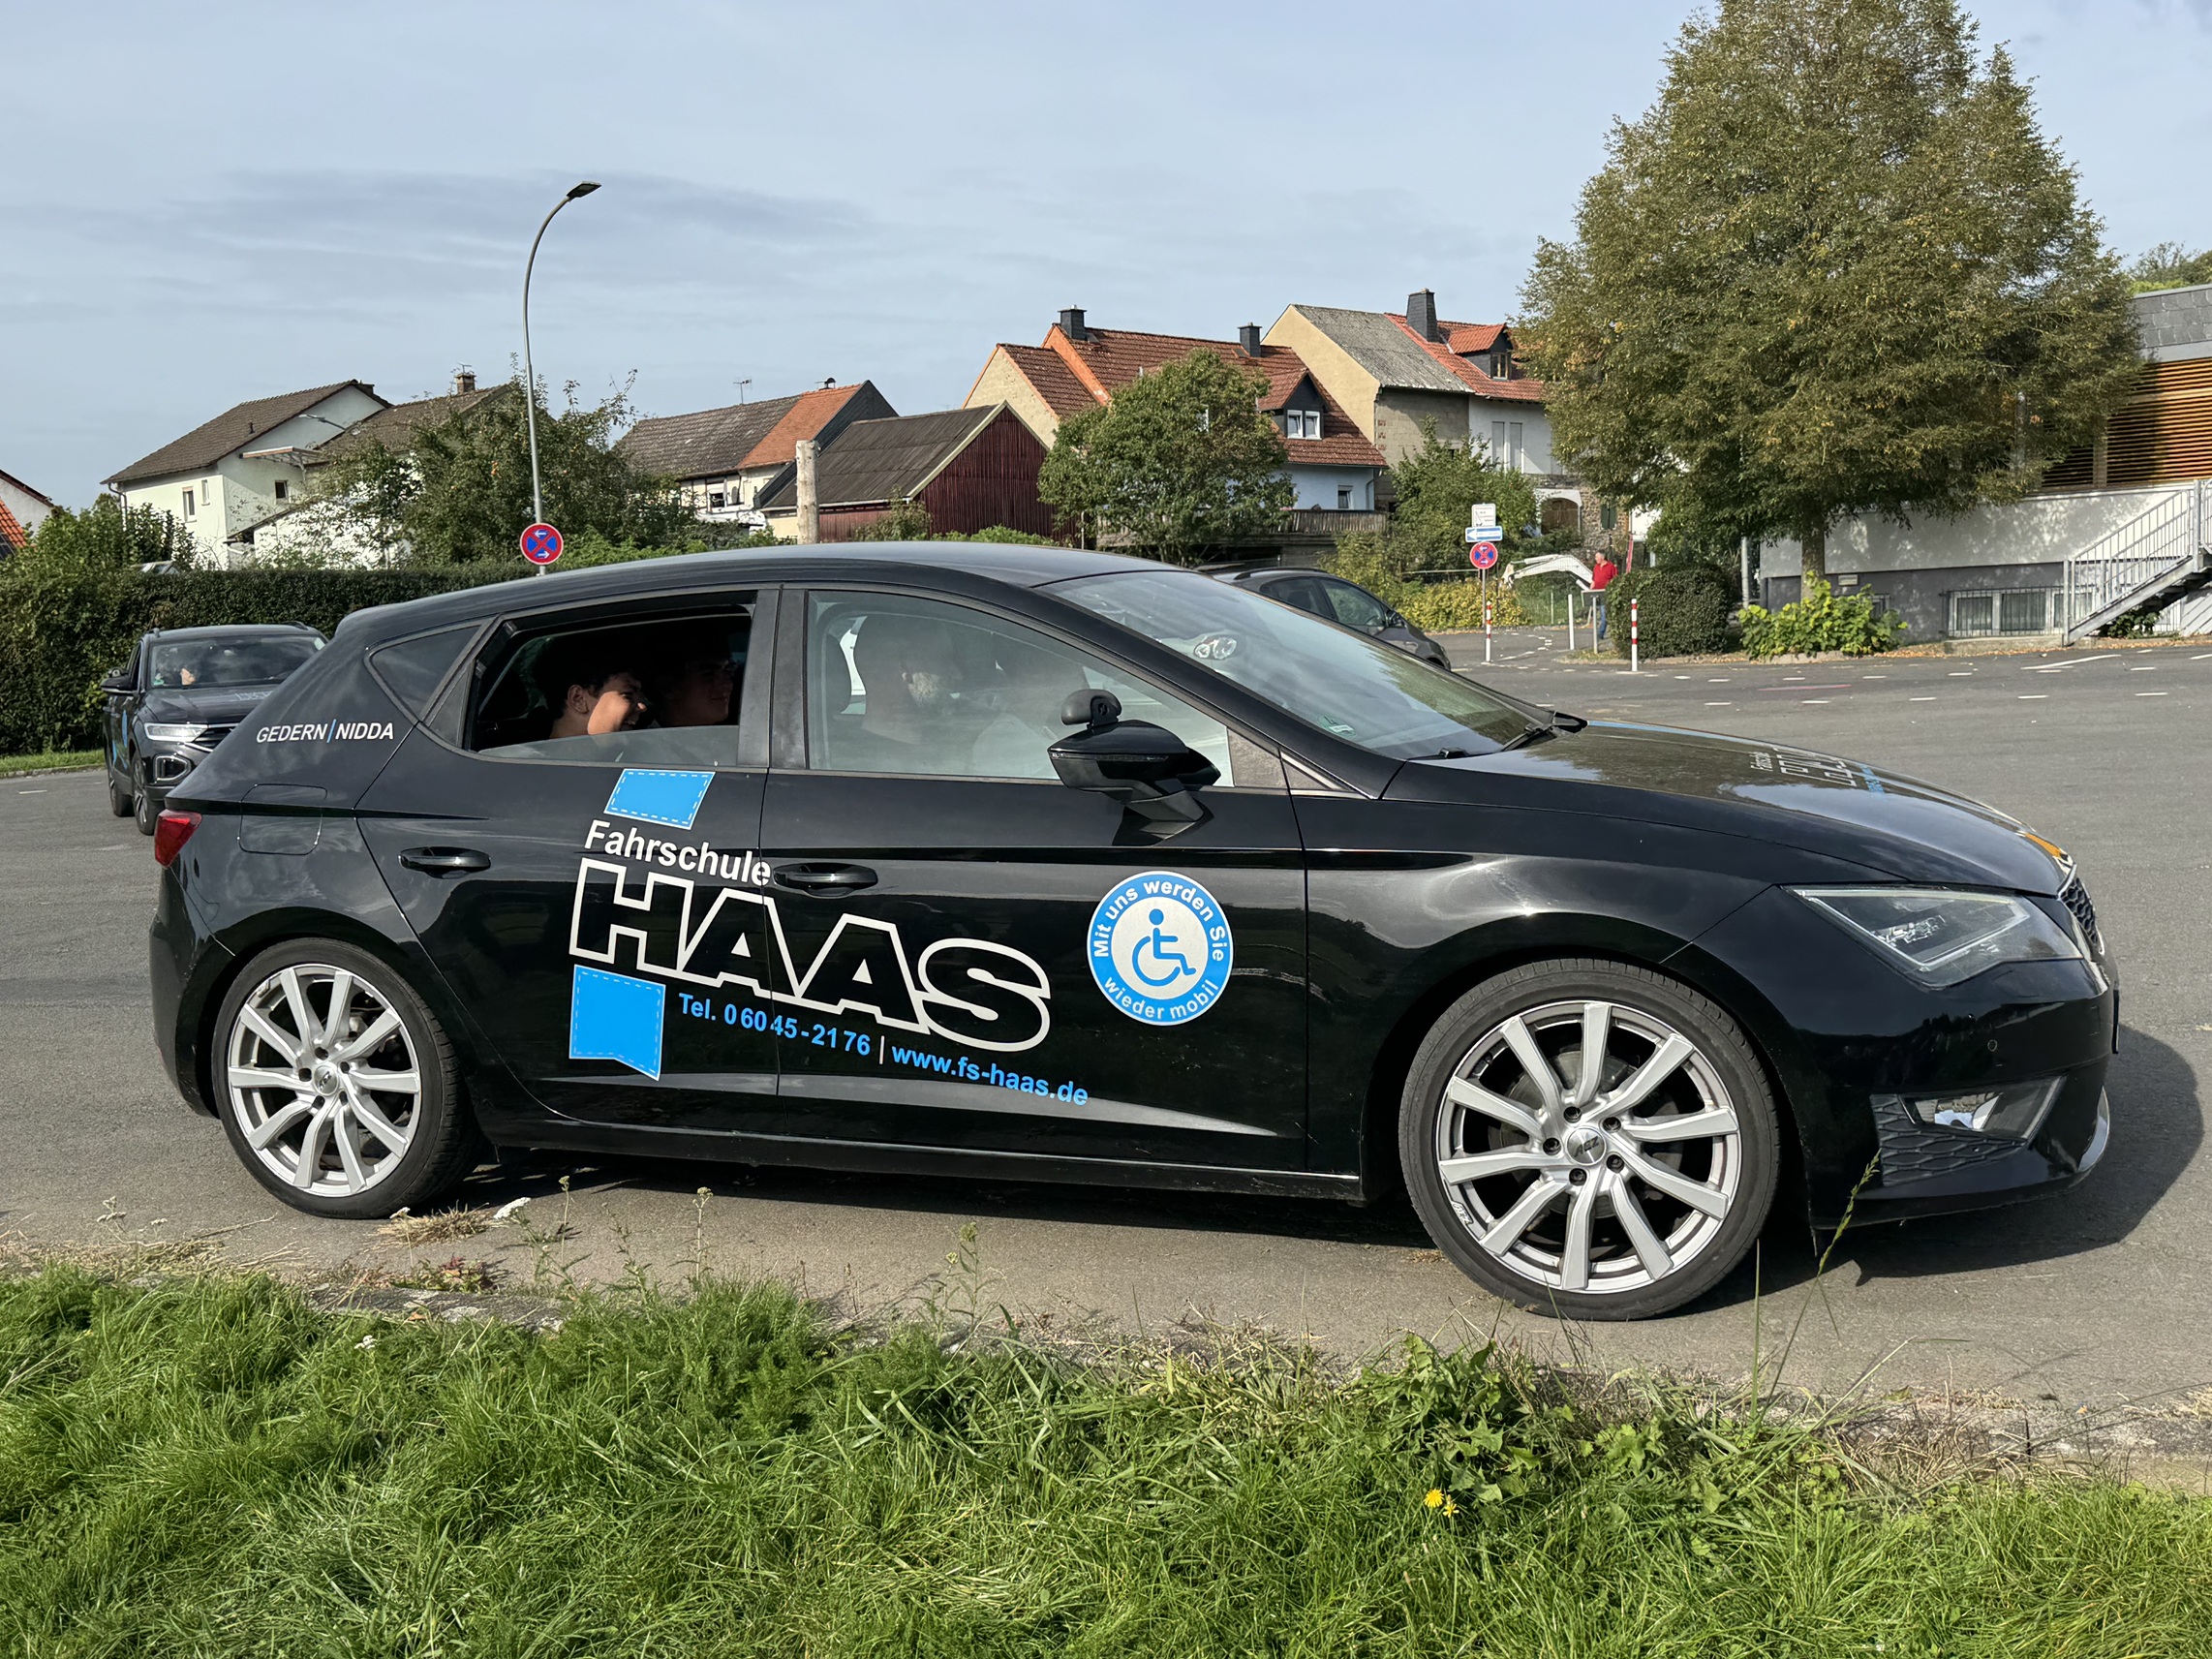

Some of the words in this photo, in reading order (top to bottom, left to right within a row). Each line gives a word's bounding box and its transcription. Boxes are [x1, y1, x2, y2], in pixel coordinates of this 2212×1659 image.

[583, 818, 772, 886] Fahrschule
[568, 857, 1052, 1052] HAAS
[1093, 923, 1112, 958] Mit
[1105, 887, 1139, 920] uns
[1143, 880, 1214, 922] werden
[1209, 925, 1228, 962] Sie
[1104, 976, 1165, 1019] wieder
[1169, 978, 1219, 1019] mobil
[678, 992, 717, 1021] Tel.
[891, 1045, 1089, 1106] www.fs-haas.de
[1574, 1135, 1599, 1157] AEZ
